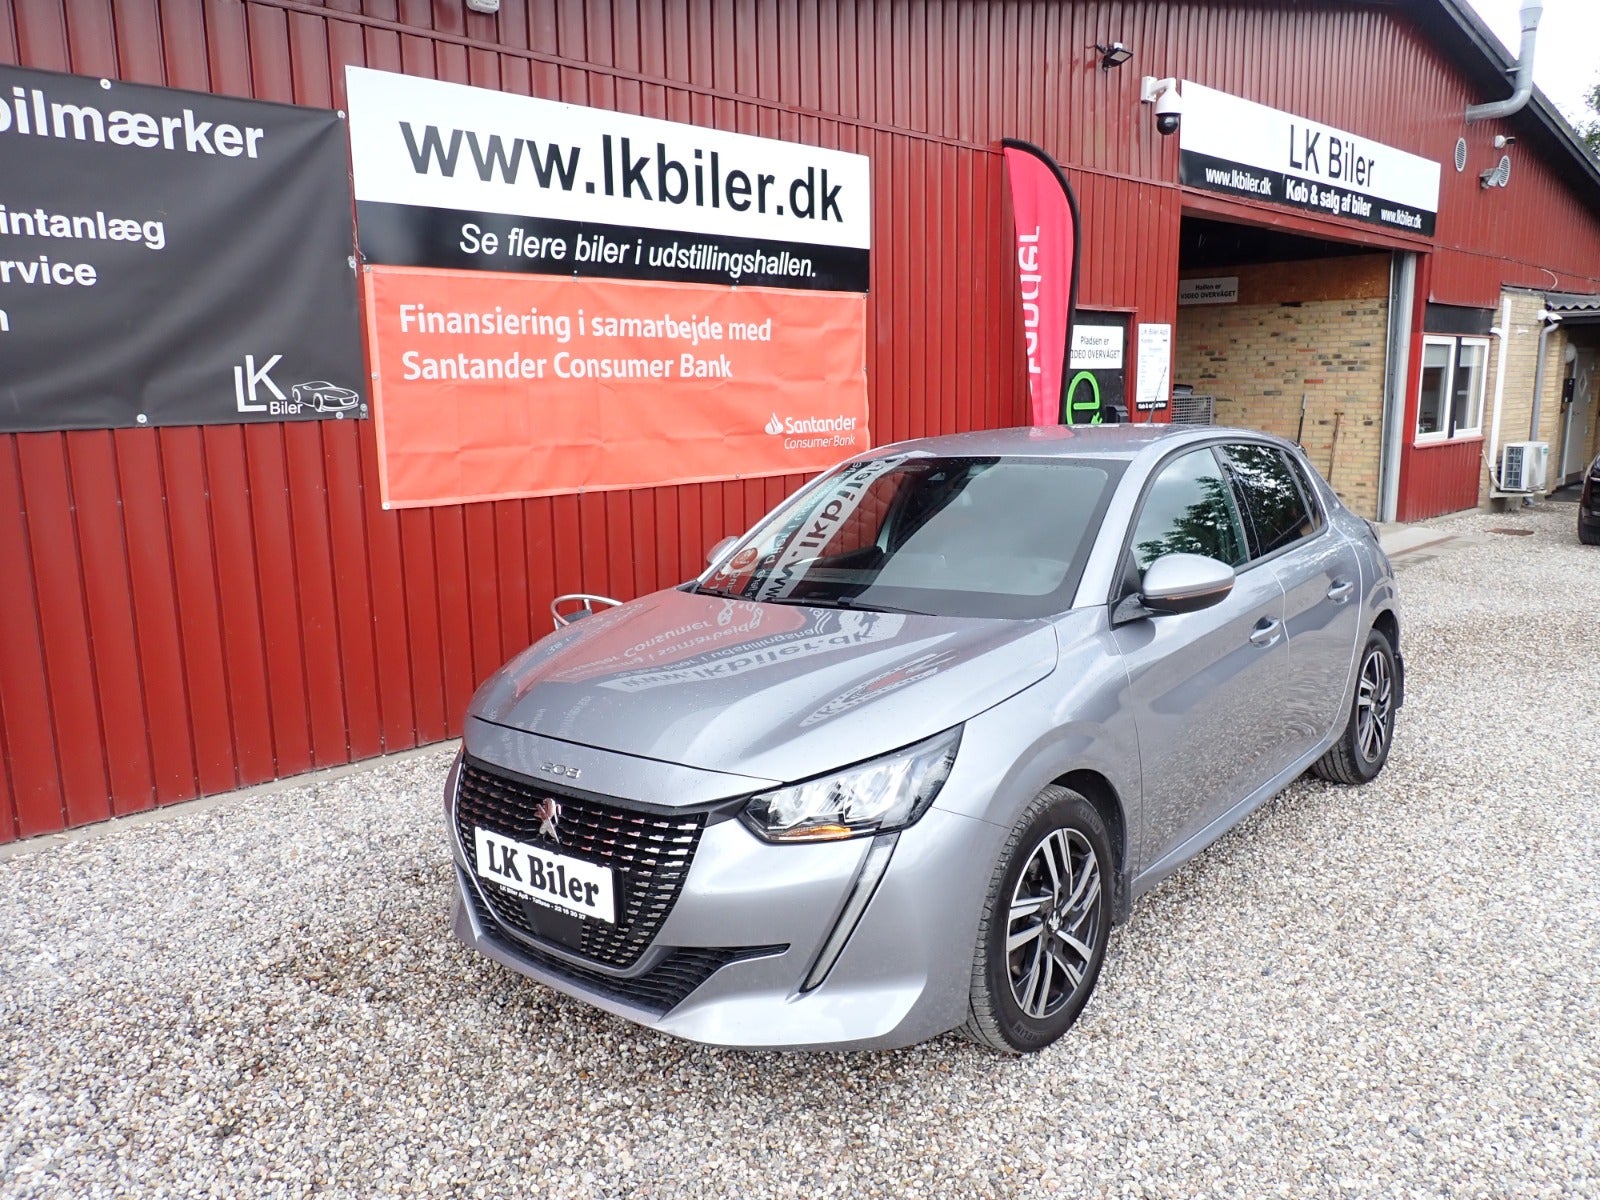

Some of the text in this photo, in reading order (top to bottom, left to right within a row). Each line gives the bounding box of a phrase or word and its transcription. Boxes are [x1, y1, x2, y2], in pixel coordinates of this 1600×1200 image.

[399, 121, 844, 223] www.lkbiler.dk
[1289, 124, 1375, 187] LK Biler
[1206, 168, 1271, 195] www.lkbiler.dk
[1286, 179, 1372, 217] Køb & salg af biler
[1381, 208, 1421, 229] www.lkbiler.dk
[460, 223, 817, 278] Se flere biler i udstillingshallen.
[399, 304, 772, 346] Finansiering i samarbejde med
[1080, 336, 1102, 346] Pladsen
[401, 351, 733, 380] Santander Consumer Bank
[1071, 348, 1120, 359] IDEO OVERVÅGET
[234, 354, 287, 412] LK
[269, 400, 303, 414] Biler
[785, 415, 857, 435] Santander
[486, 839, 599, 908] LK Biler
